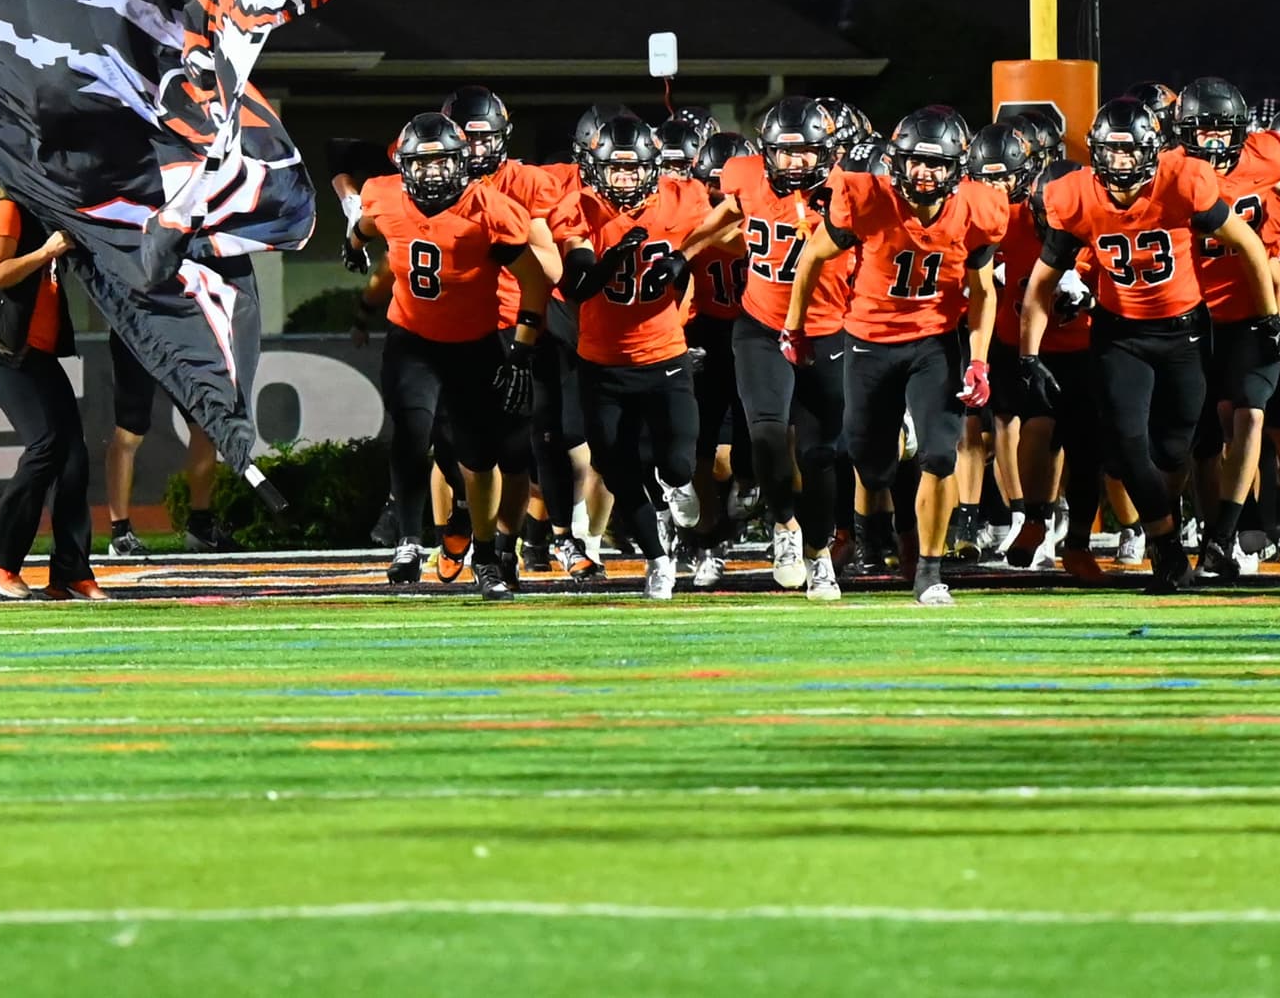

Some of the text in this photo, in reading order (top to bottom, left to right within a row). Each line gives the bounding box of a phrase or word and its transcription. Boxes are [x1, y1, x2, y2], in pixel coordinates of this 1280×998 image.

[408, 239, 442, 301] 8
[746, 216, 808, 284] 27
[887, 249, 944, 301] 11
[1096, 228, 1176, 289] 33
